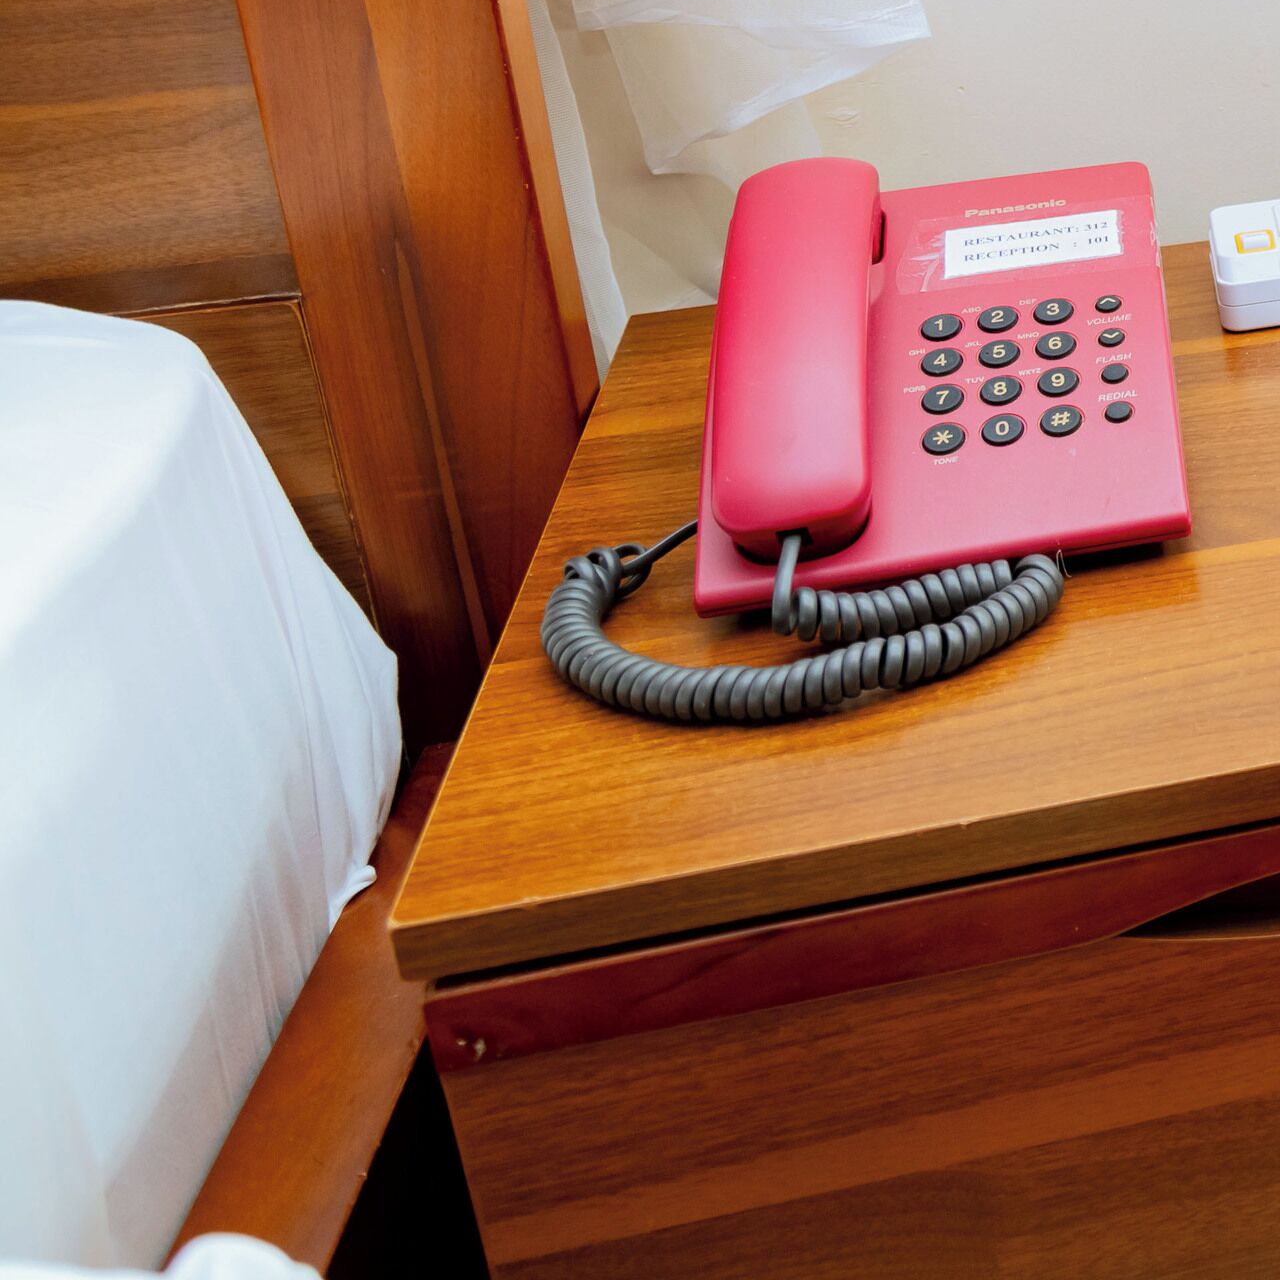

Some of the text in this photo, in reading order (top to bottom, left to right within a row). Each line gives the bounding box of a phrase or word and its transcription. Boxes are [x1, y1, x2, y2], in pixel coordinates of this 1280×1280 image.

[964, 199, 1067, 218] Panasonic
[964, 221, 1108, 247] RESTAURANT: 312
[964, 242, 1060, 263] RECEPTION
[1087, 236, 1109, 246] 101
[1019, 298, 1037, 306] DEF
[961, 306, 982, 315] ABC
[1046, 303, 1060, 316] 3
[991, 310, 1004, 323] 2
[1086, 314, 1132, 326] VOLUME
[933, 319, 943, 332] 1
[1017, 331, 1040, 340] MNO
[964, 340, 982, 349] JKL
[1048, 336, 1062, 350] 6
[908, 348, 926, 357] GHI
[992, 344, 1006, 359] 5
[933, 353, 947, 367] 4
[1095, 353, 1132, 364] FLASH
[1018, 368, 1041, 377] WXYZ
[965, 376, 985, 385] TUV
[1051, 373, 1065, 387] 9
[903, 385, 926, 394] PQRS
[993, 381, 1007, 396] 8
[936, 390, 950, 405] 7
[1098, 390, 1138, 402] REDIAL
[995, 420, 1010, 436] 0
[933, 456, 959, 466] TONE
